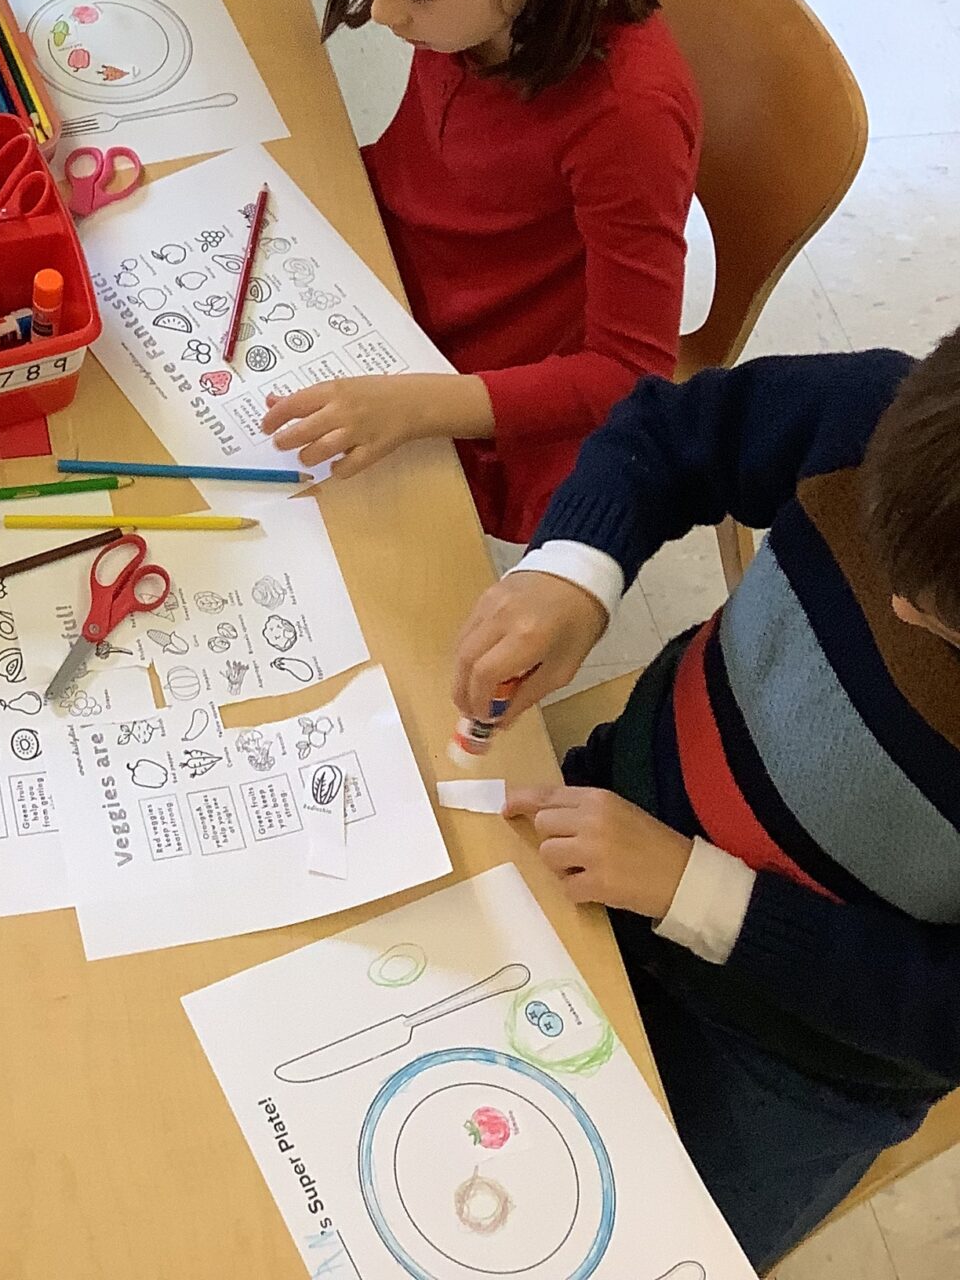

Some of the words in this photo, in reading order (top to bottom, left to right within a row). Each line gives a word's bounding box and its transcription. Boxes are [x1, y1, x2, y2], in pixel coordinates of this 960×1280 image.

[85, 269, 167, 361] Fantastic!
[26, 363, 42, 381] 8
[52, 357, 69, 373] 9
[160, 359, 193, 396] are
[184, 393, 242, 458] Fruits
[88, 731, 111, 769] are
[15, 781, 26, 802] fruits
[27, 785, 36, 800] you
[35, 777, 49, 806] getting
[211, 796, 219, 807] see
[245, 786, 259, 808] fruits
[255, 788, 270, 808] keep
[265, 783, 279, 808] bones
[19, 803, 31, 829] Green
[28, 803, 40, 821] help
[40, 809, 50, 827] from
[144, 802, 161, 835] veggies
[156, 806, 168, 825] your
[200, 793, 216, 822] veggies
[214, 809, 225, 825] you
[262, 809, 275, 829] help
[273, 809, 287, 829] your
[95, 773, 138, 867] Veggies
[194, 805, 211, 840] Orange&
[227, 824, 236, 834] at
[251, 808, 267, 835] Green
[152, 836, 163, 853] Red
[160, 827, 173, 848] keep
[170, 828, 183, 851] heart
[208, 824, 223, 849] yellow
[218, 826, 230, 843] help
[256, 1095, 296, 1153] Plate!
[285, 1151, 329, 1214] Super
[315, 1215, 335, 1234] 's
